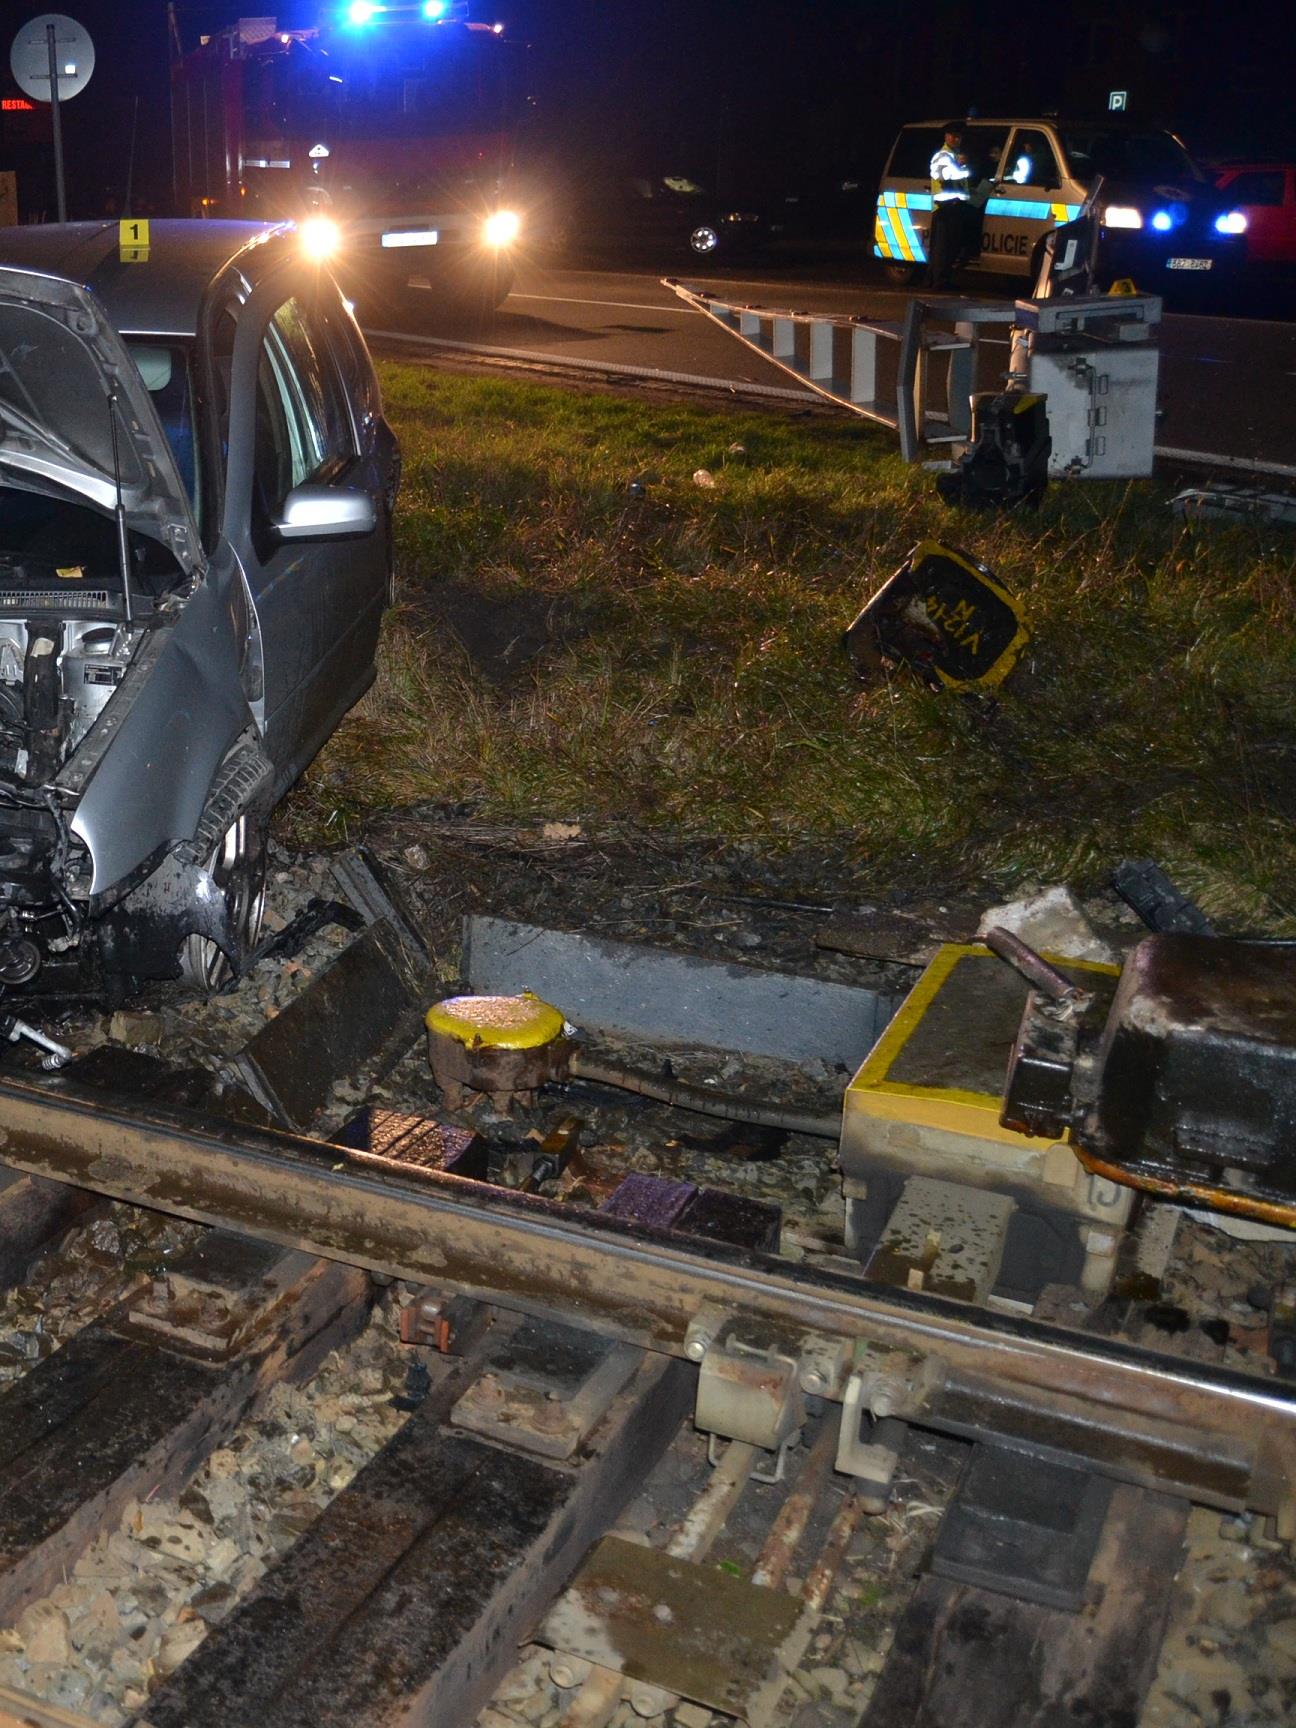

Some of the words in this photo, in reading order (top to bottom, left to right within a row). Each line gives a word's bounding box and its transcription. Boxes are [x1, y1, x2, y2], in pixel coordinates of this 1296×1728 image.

[1112, 95, 1123, 110] P
[129, 224, 138, 240] 1
[981, 232, 1029, 255] OLICIE
